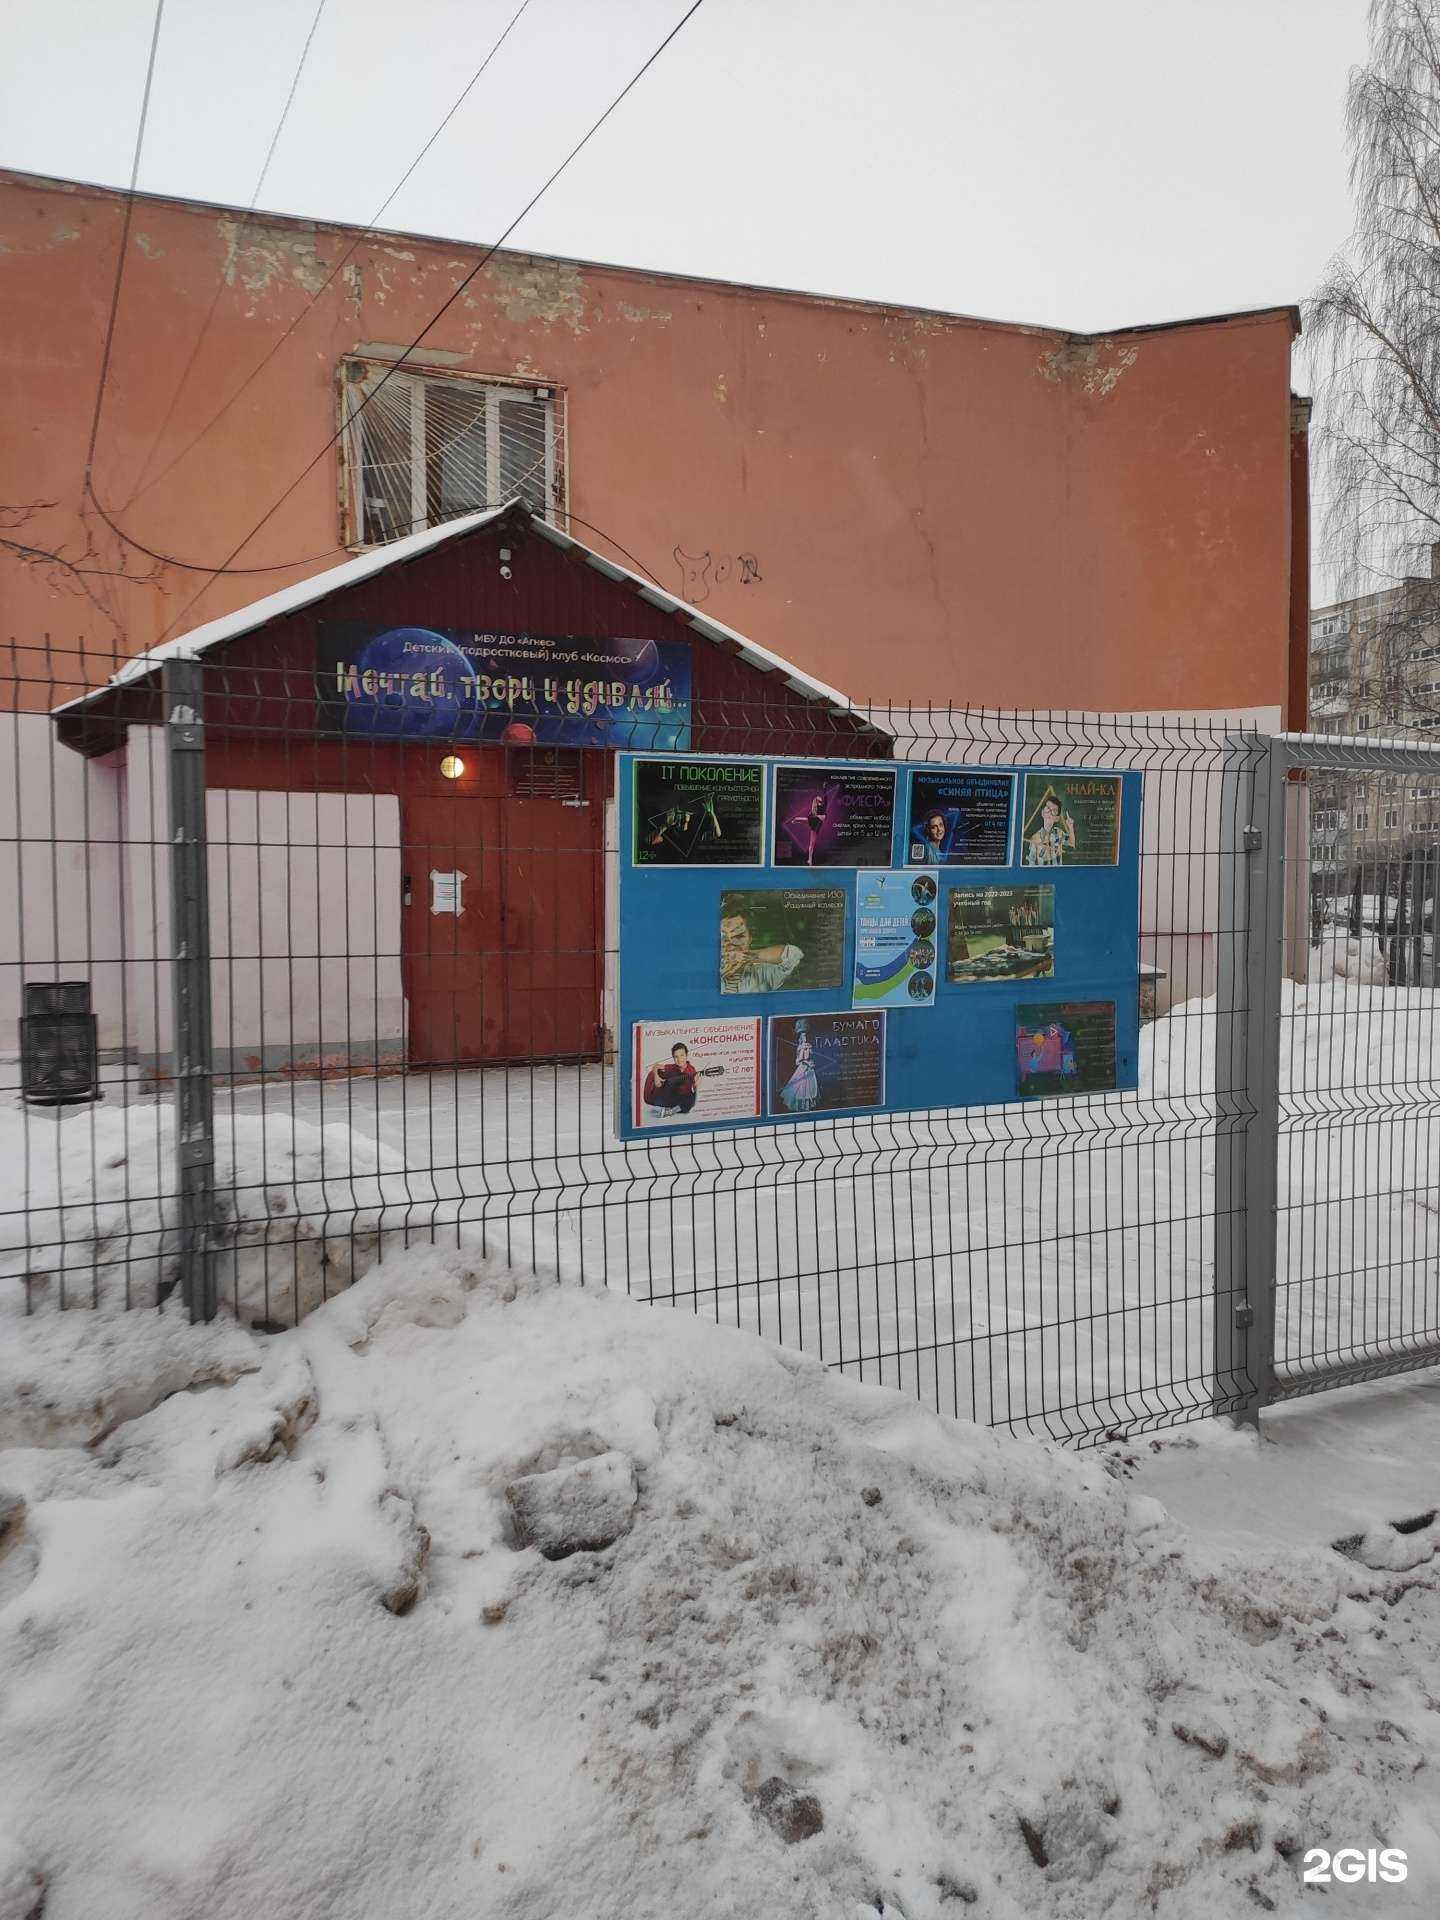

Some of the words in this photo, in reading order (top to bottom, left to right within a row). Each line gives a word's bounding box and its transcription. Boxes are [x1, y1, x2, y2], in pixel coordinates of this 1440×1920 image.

[474, 634, 497, 643] МБУ
[499, 635, 516, 645] ДО
[457, 647, 549, 661] (подростковый)
[552, 650, 578, 663] клуб
[581, 652, 632, 664] «Космос»
[680, 767, 760, 782] ПОКОЛЕНИЕ
[833, 1020, 880, 1031] БУМАГО
[645, 1028, 700, 1037] МУЗЫКАЛЬНОЕ
[689, 1034, 754, 1045] «КОНСОНАНС»
[815, 1035, 880, 1048] ПЛАСТИКА
